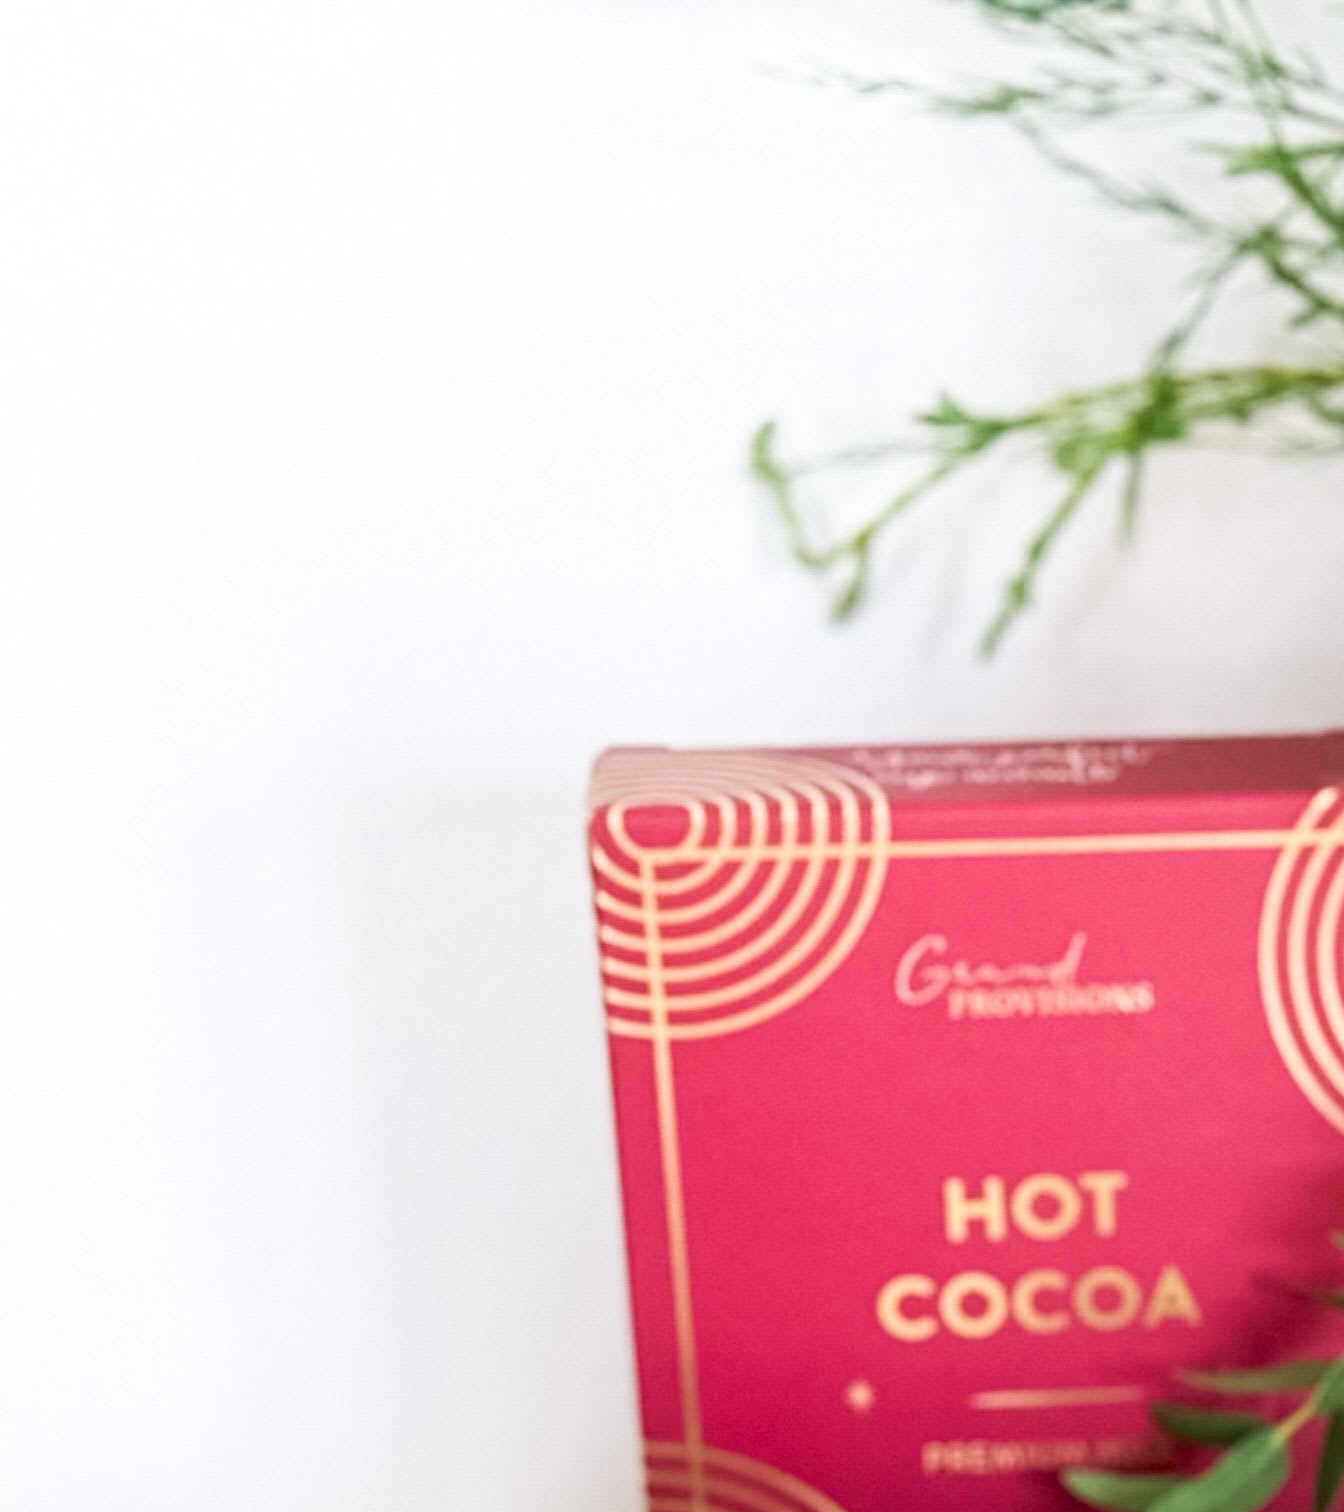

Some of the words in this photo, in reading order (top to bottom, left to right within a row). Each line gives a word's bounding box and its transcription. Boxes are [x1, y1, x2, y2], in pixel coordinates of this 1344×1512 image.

[894, 930, 1088, 1006] Grand
[948, 980, 1156, 1021] PROVISIONS
[943, 1170, 1129, 1245] HOT
[875, 1264, 1202, 1342] COCOA
